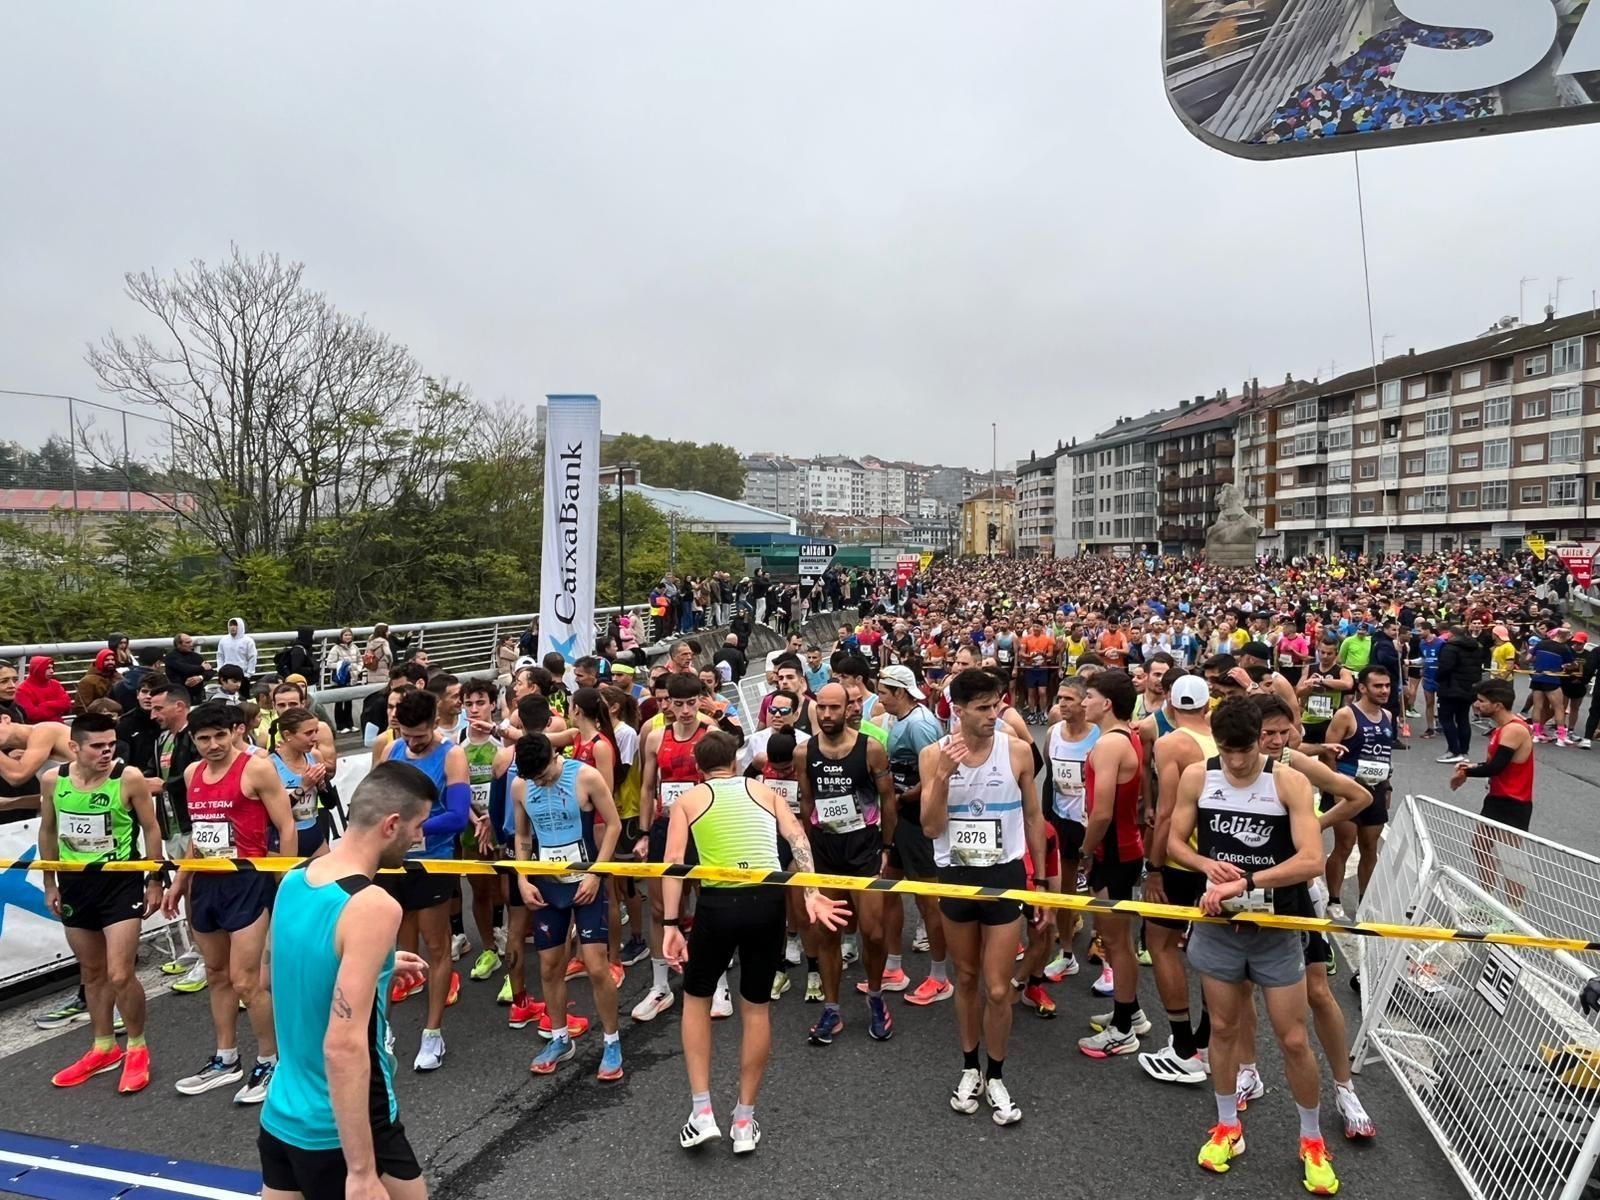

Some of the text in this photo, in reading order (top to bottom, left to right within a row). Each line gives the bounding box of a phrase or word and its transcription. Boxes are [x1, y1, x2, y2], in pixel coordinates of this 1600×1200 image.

[554, 440, 583, 625] CaixaBank
[828, 545, 832, 556] 1
[1057, 768, 1072, 778] 165
[1361, 766, 1384, 777] 2886
[823, 777, 852, 785] BARCO
[207, 800, 233, 809] TEAM
[823, 804, 849, 818] 2885
[69, 822, 92, 834] 162
[1209, 813, 1274, 838] delikia
[196, 831, 220, 843] 2876
[956, 831, 987, 844] 2878
